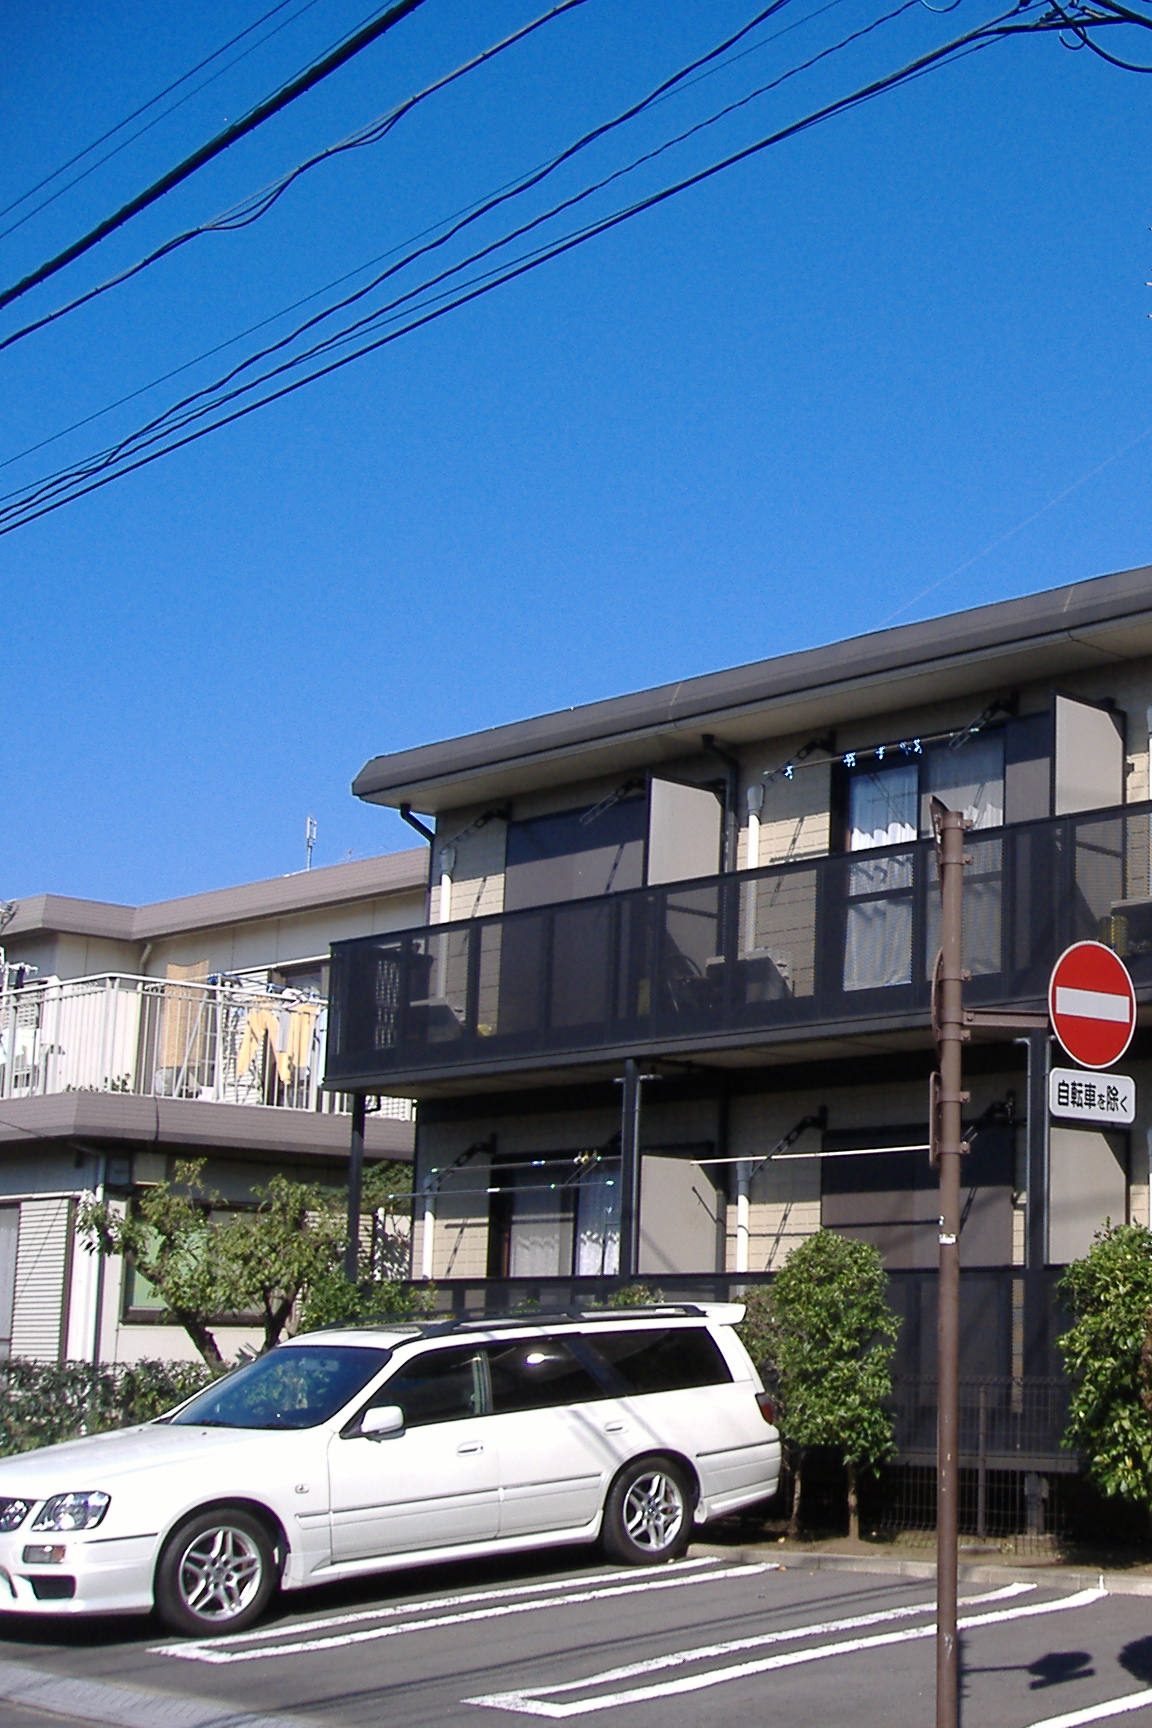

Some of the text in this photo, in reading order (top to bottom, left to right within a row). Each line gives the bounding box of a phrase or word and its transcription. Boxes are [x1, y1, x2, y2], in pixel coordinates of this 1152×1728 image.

[1058, 1079, 1128, 1113] 自転車を除く
